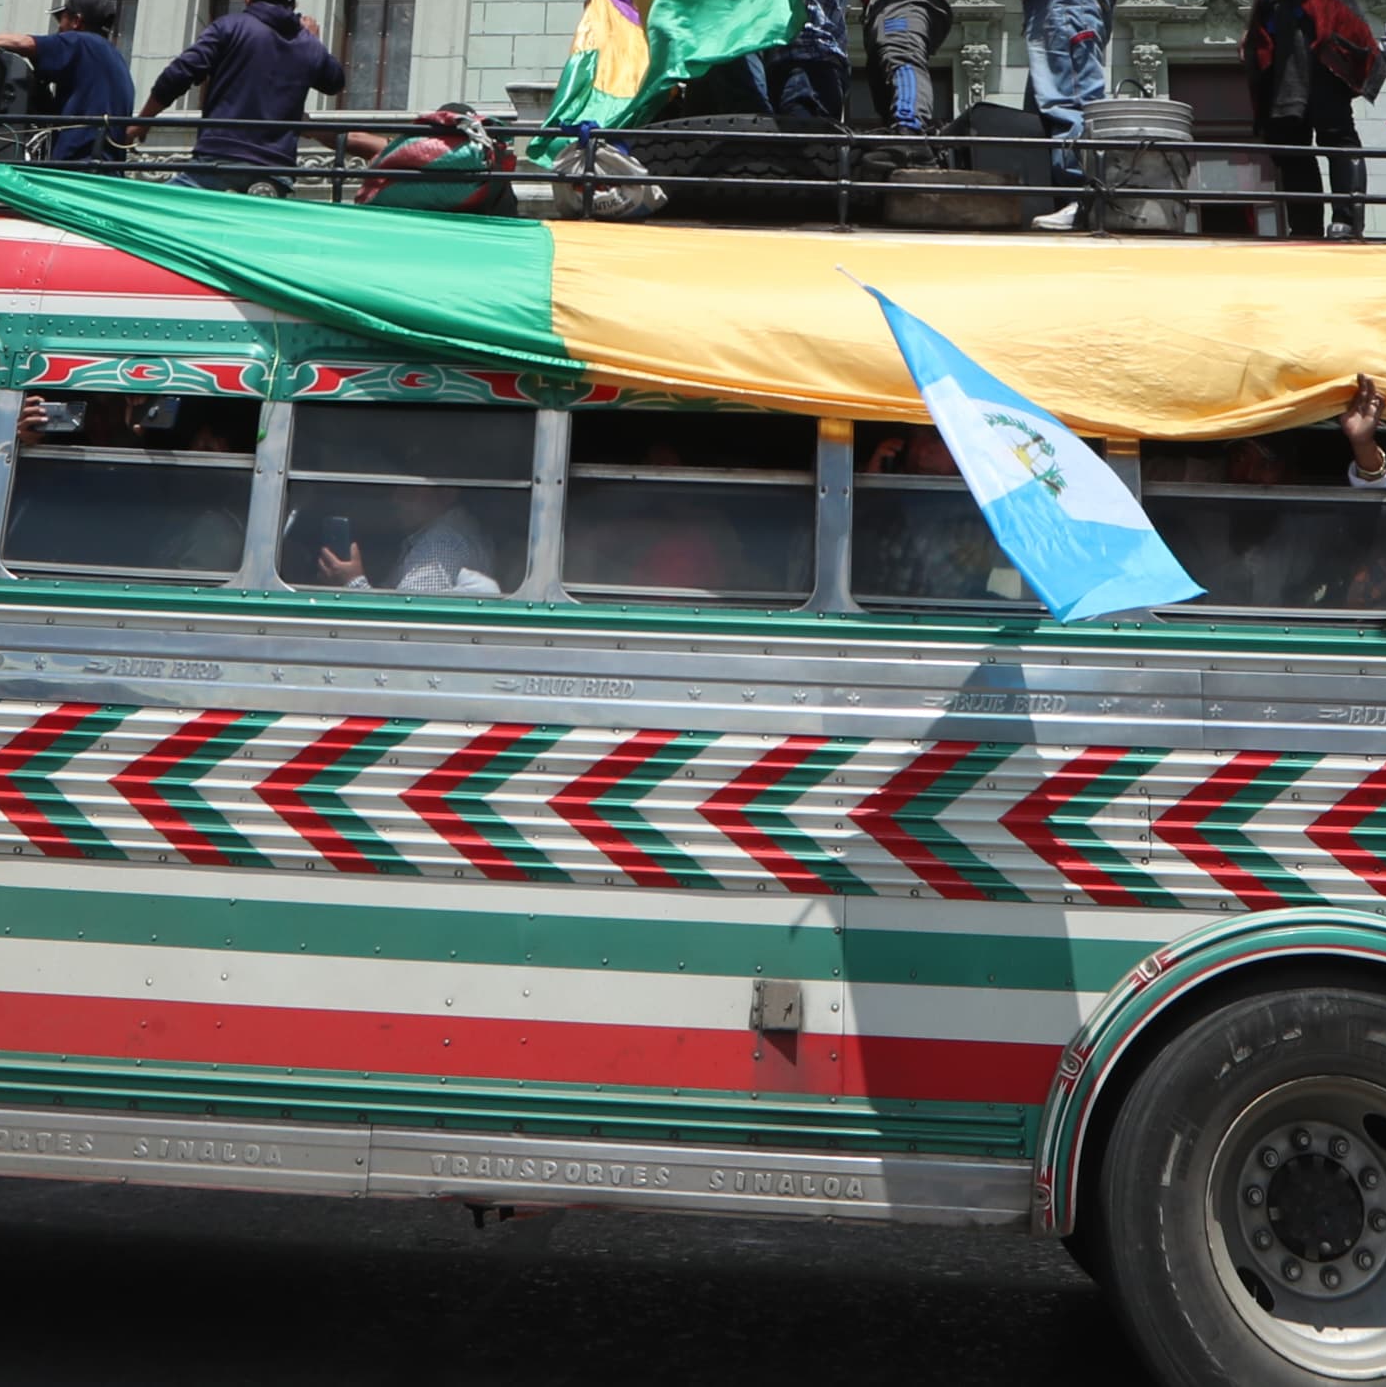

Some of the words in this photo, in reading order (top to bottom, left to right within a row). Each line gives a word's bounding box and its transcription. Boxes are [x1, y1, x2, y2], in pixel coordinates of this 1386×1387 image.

[522, 677, 575, 697] BLUE
[581, 678, 636, 699] BIRD
[951, 693, 1008, 712] BLUE
[1012, 694, 1067, 714] BIRD
[132, 1136, 284, 1167] SINALOA
[430, 1154, 672, 1188] TRANSPORTES
[708, 1169, 866, 1201] SINALOA
